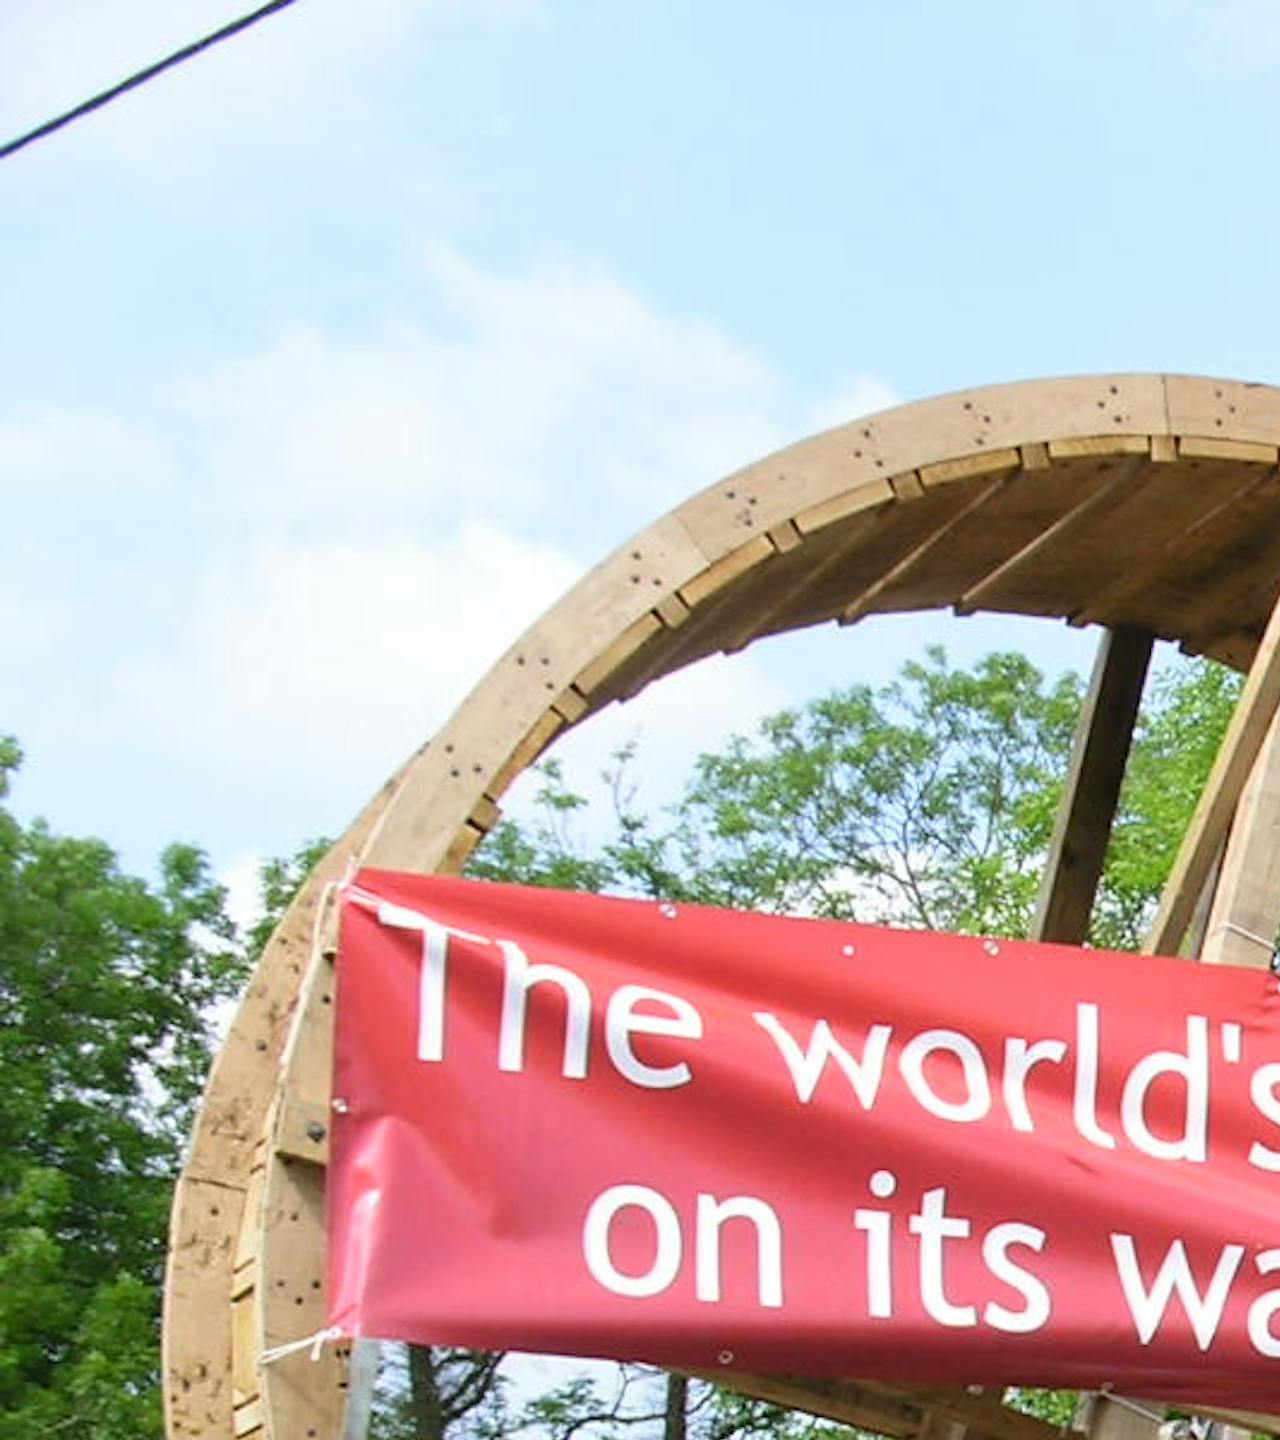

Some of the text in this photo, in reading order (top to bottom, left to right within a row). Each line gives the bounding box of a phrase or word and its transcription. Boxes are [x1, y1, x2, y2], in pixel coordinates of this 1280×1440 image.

[380, 903, 703, 1088] The
[583, 1184, 783, 1308] on
[855, 1171, 1052, 1333] its
